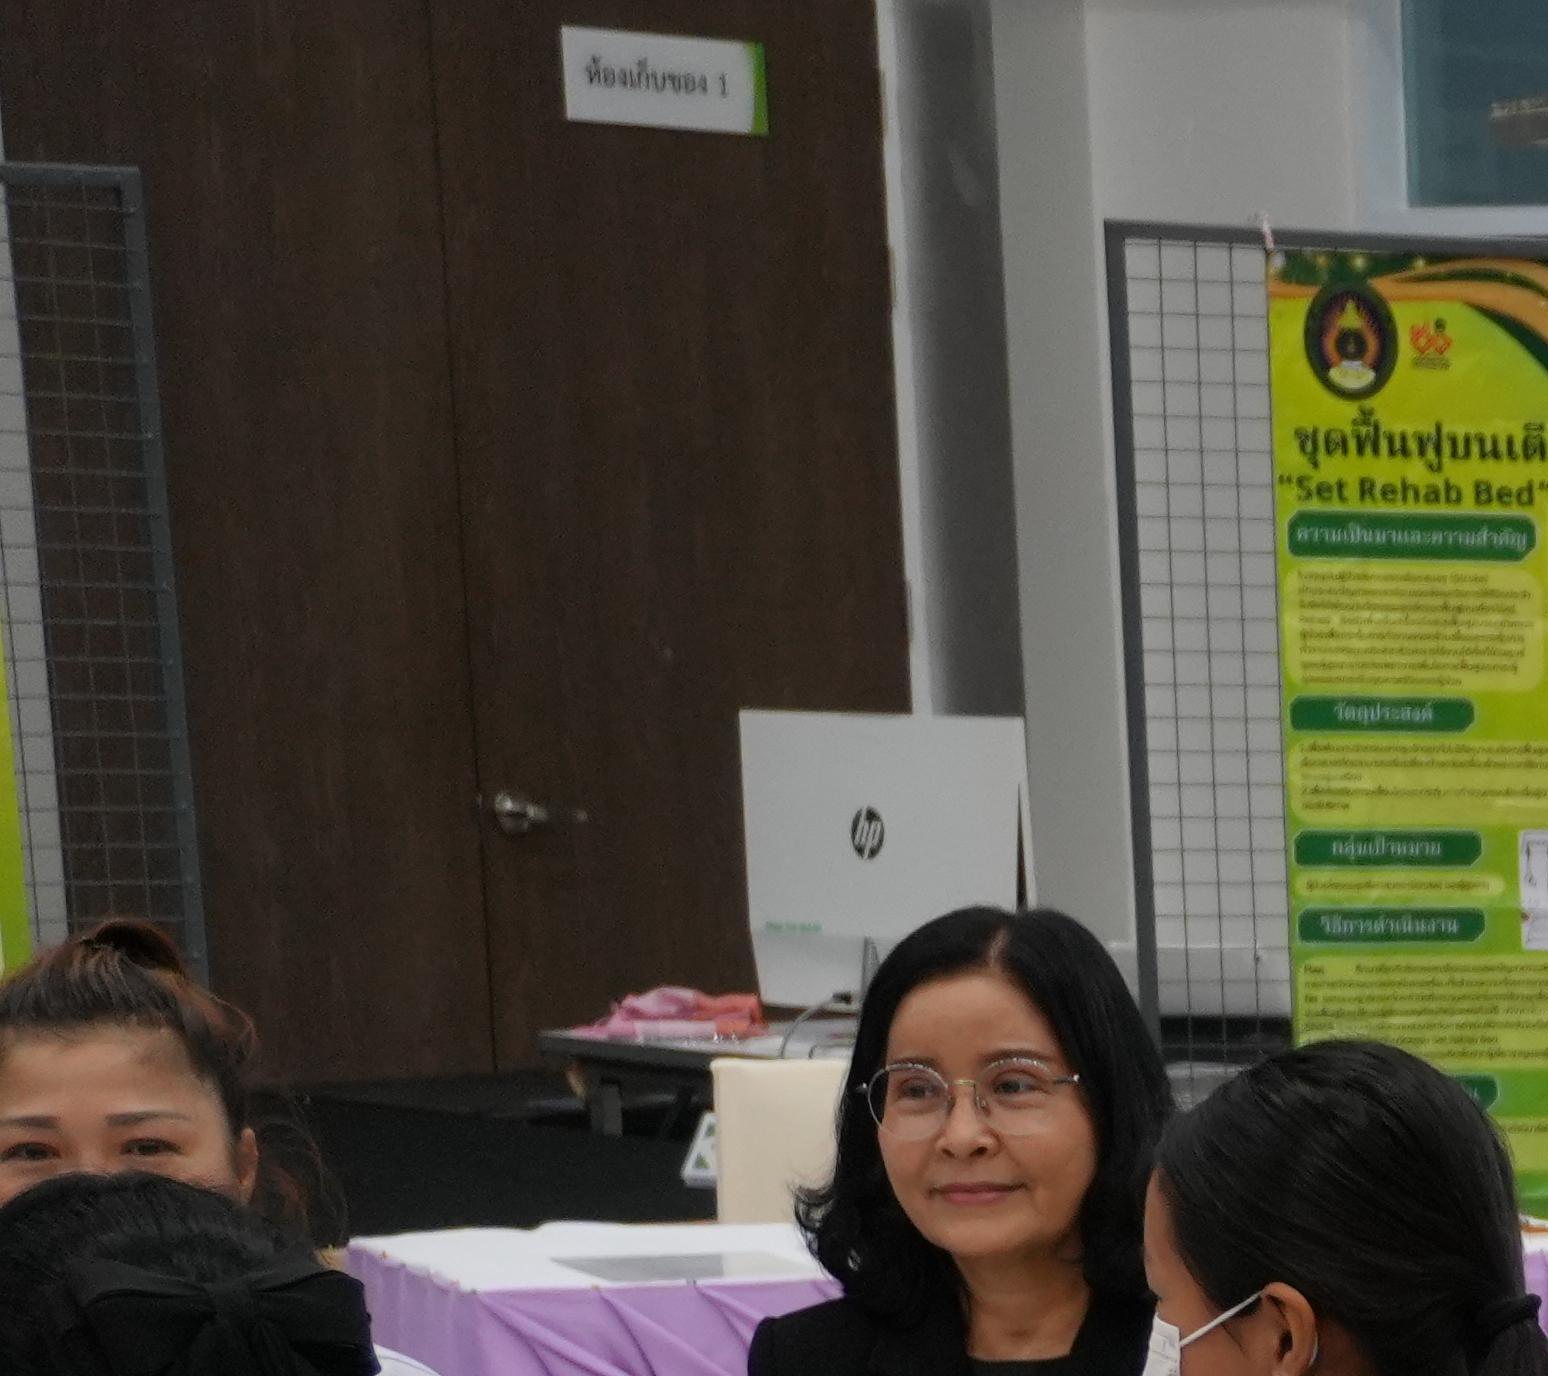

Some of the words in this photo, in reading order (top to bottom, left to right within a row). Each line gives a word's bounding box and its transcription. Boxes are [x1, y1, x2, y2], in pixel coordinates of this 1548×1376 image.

[584, 53, 708, 96] ห้องเก็บของ
[1358, 476, 1463, 506] Rehab
